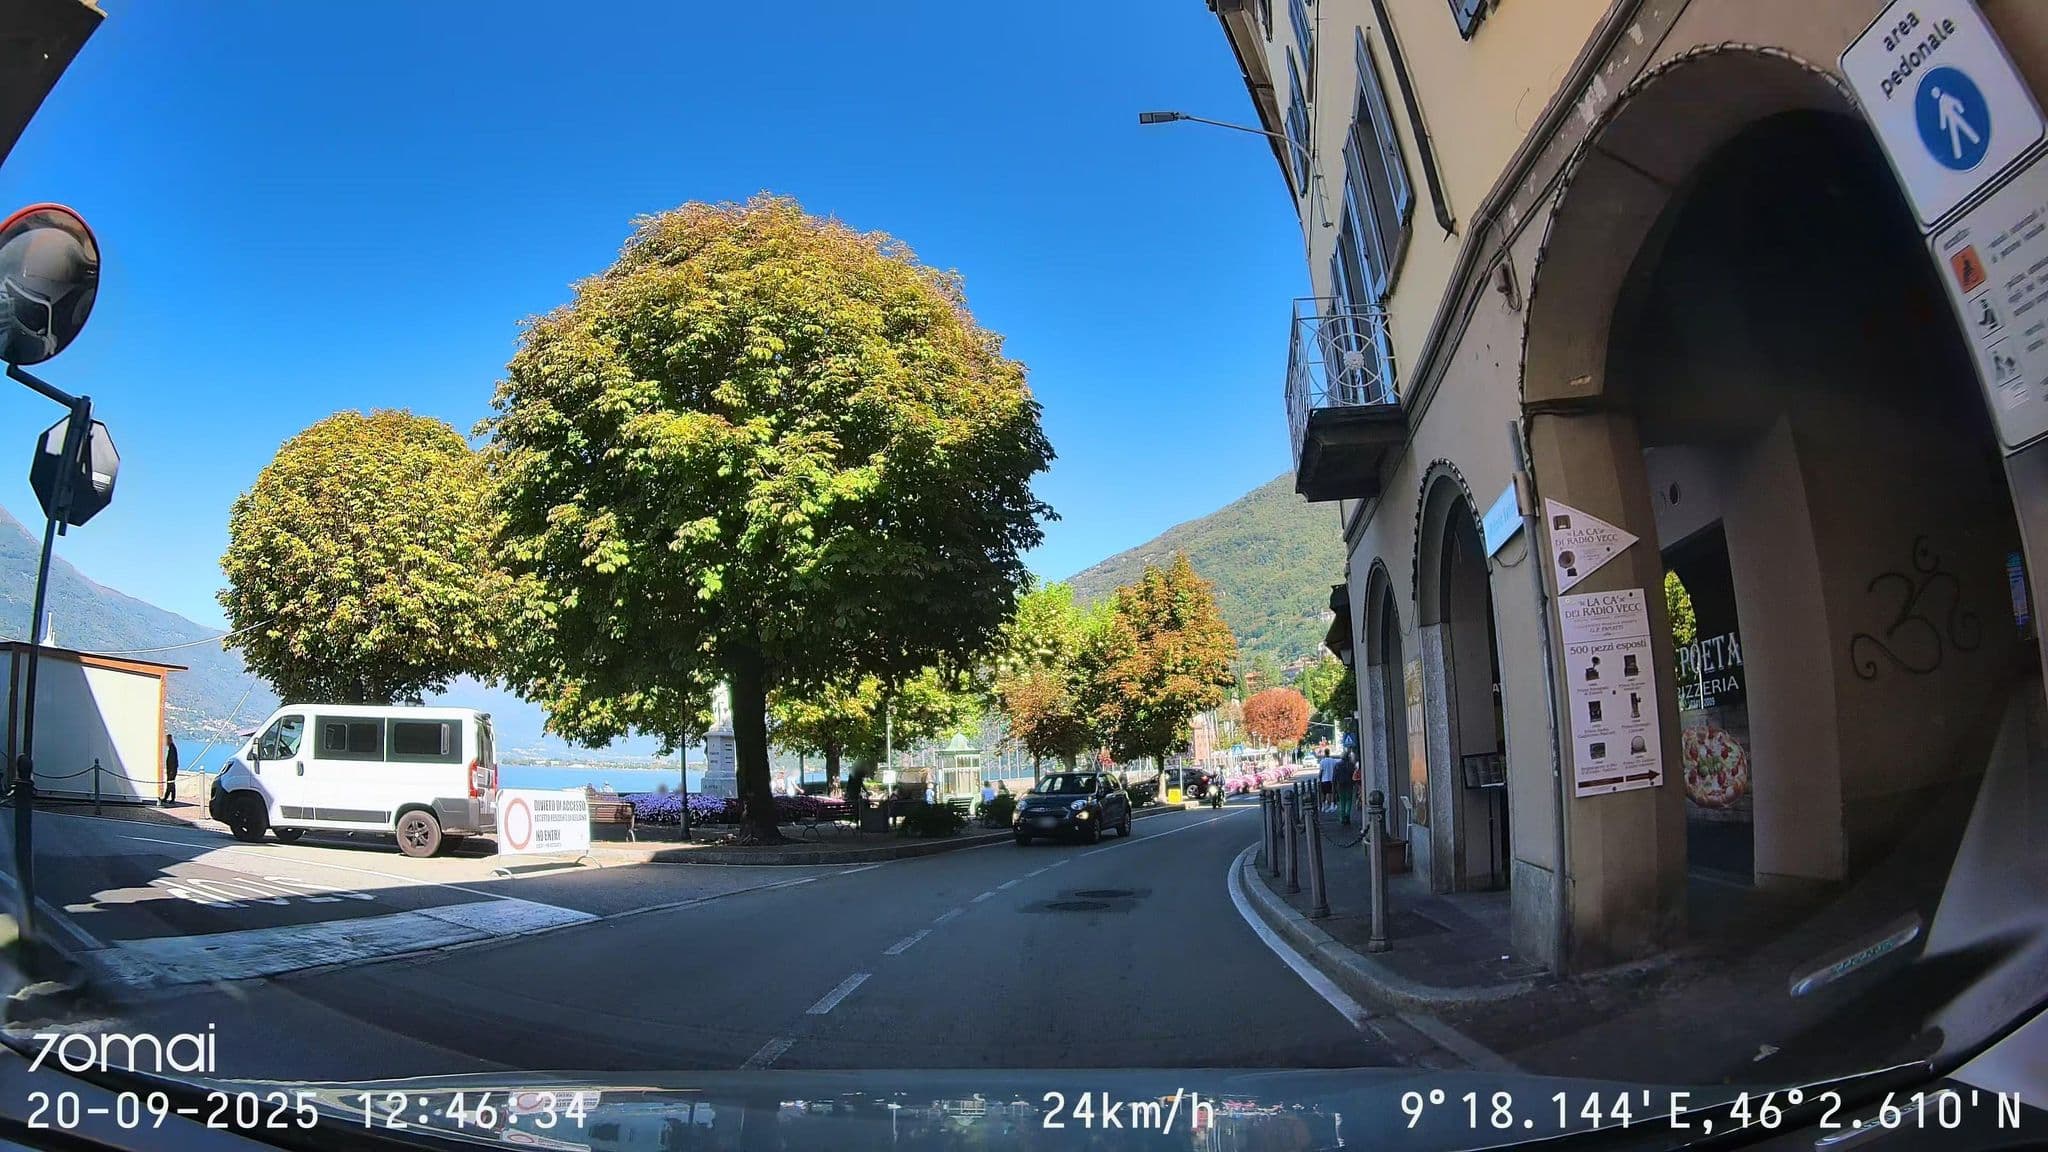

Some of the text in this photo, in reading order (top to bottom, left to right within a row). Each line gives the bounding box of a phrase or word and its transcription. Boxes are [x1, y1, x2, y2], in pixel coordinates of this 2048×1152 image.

[1883, 12, 1920, 51] area
[1881, 19, 1955, 99] pedonale
[1567, 536, 1594, 545] RADIO
[1597, 534, 1618, 543] VECC
[1587, 598, 1600, 607] LA
[1582, 605, 1614, 617] RADIO
[1616, 603, 1642, 613] VECC
[1570, 639, 1647, 654] 500 pezzi esposti
[1680, 632, 1743, 676] POETA
[563, 800, 586, 811] ACCESSO
[536, 829, 561, 841] NO ENTRY
